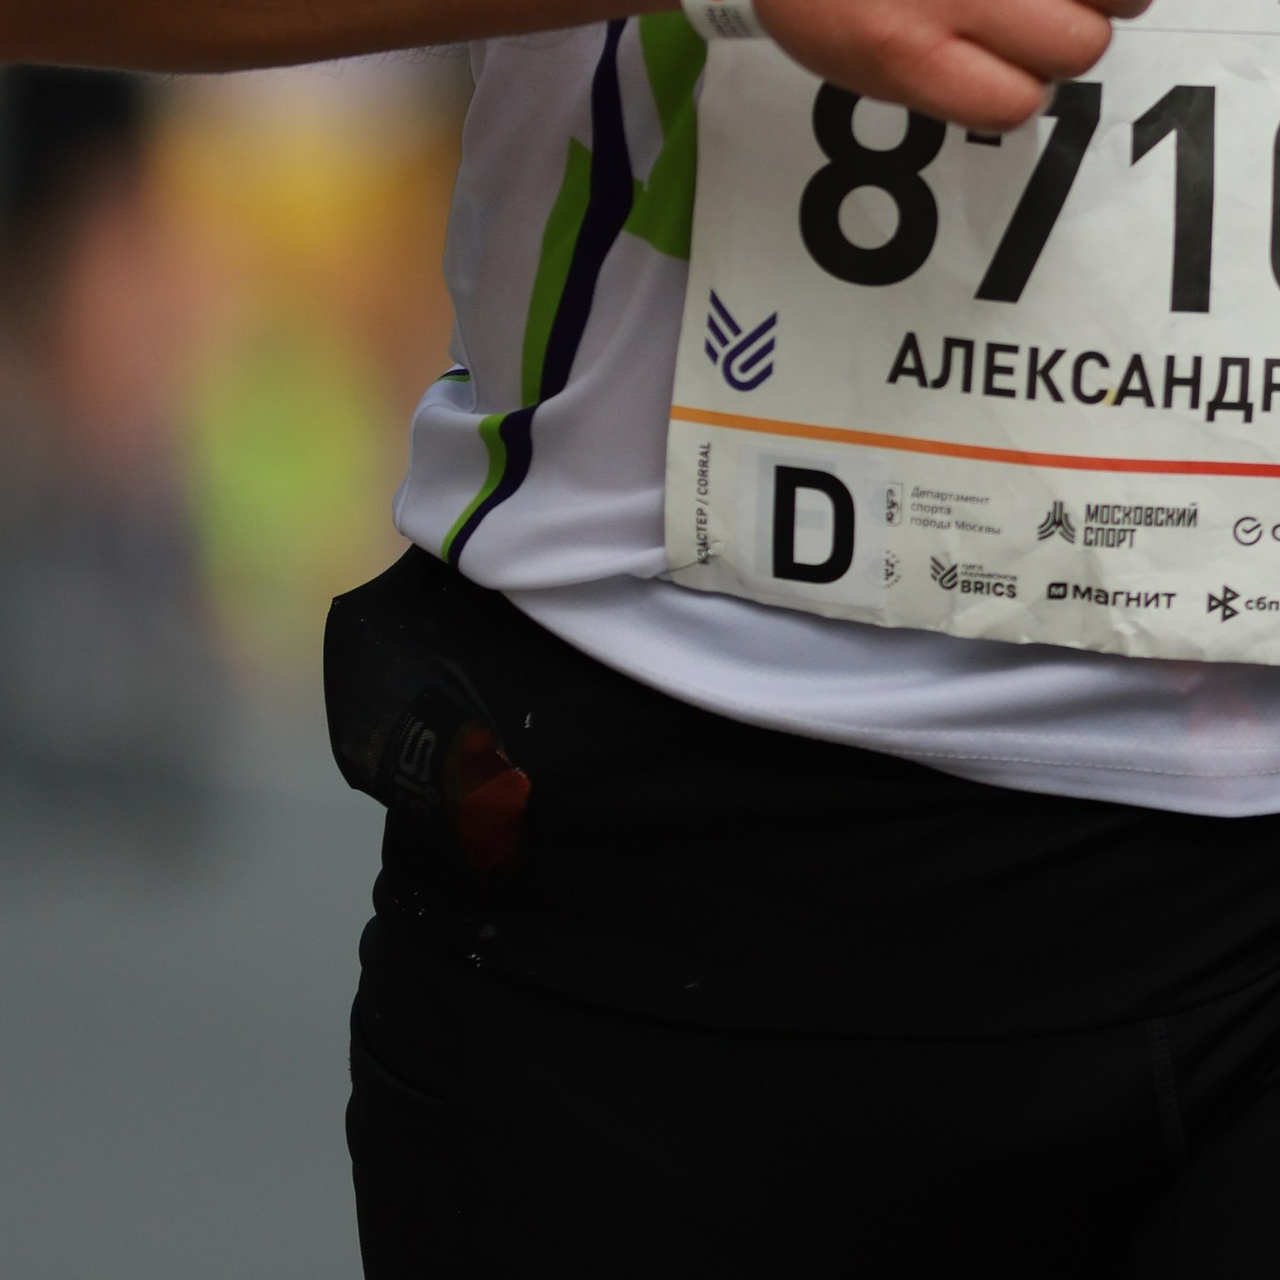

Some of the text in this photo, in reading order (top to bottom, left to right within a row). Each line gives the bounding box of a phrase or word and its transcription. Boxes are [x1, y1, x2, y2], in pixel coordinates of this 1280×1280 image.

[696, 442, 711, 496] CORRAL
[910, 487, 990, 505] Департамент
[910, 502, 953, 515] спорта
[1084, 502, 1198, 528] МОСКОВСКИЙ
[773, 464, 855, 585] D
[1083, 527, 1137, 548] СПОРТ
[961, 580, 1017, 598] BRICS
